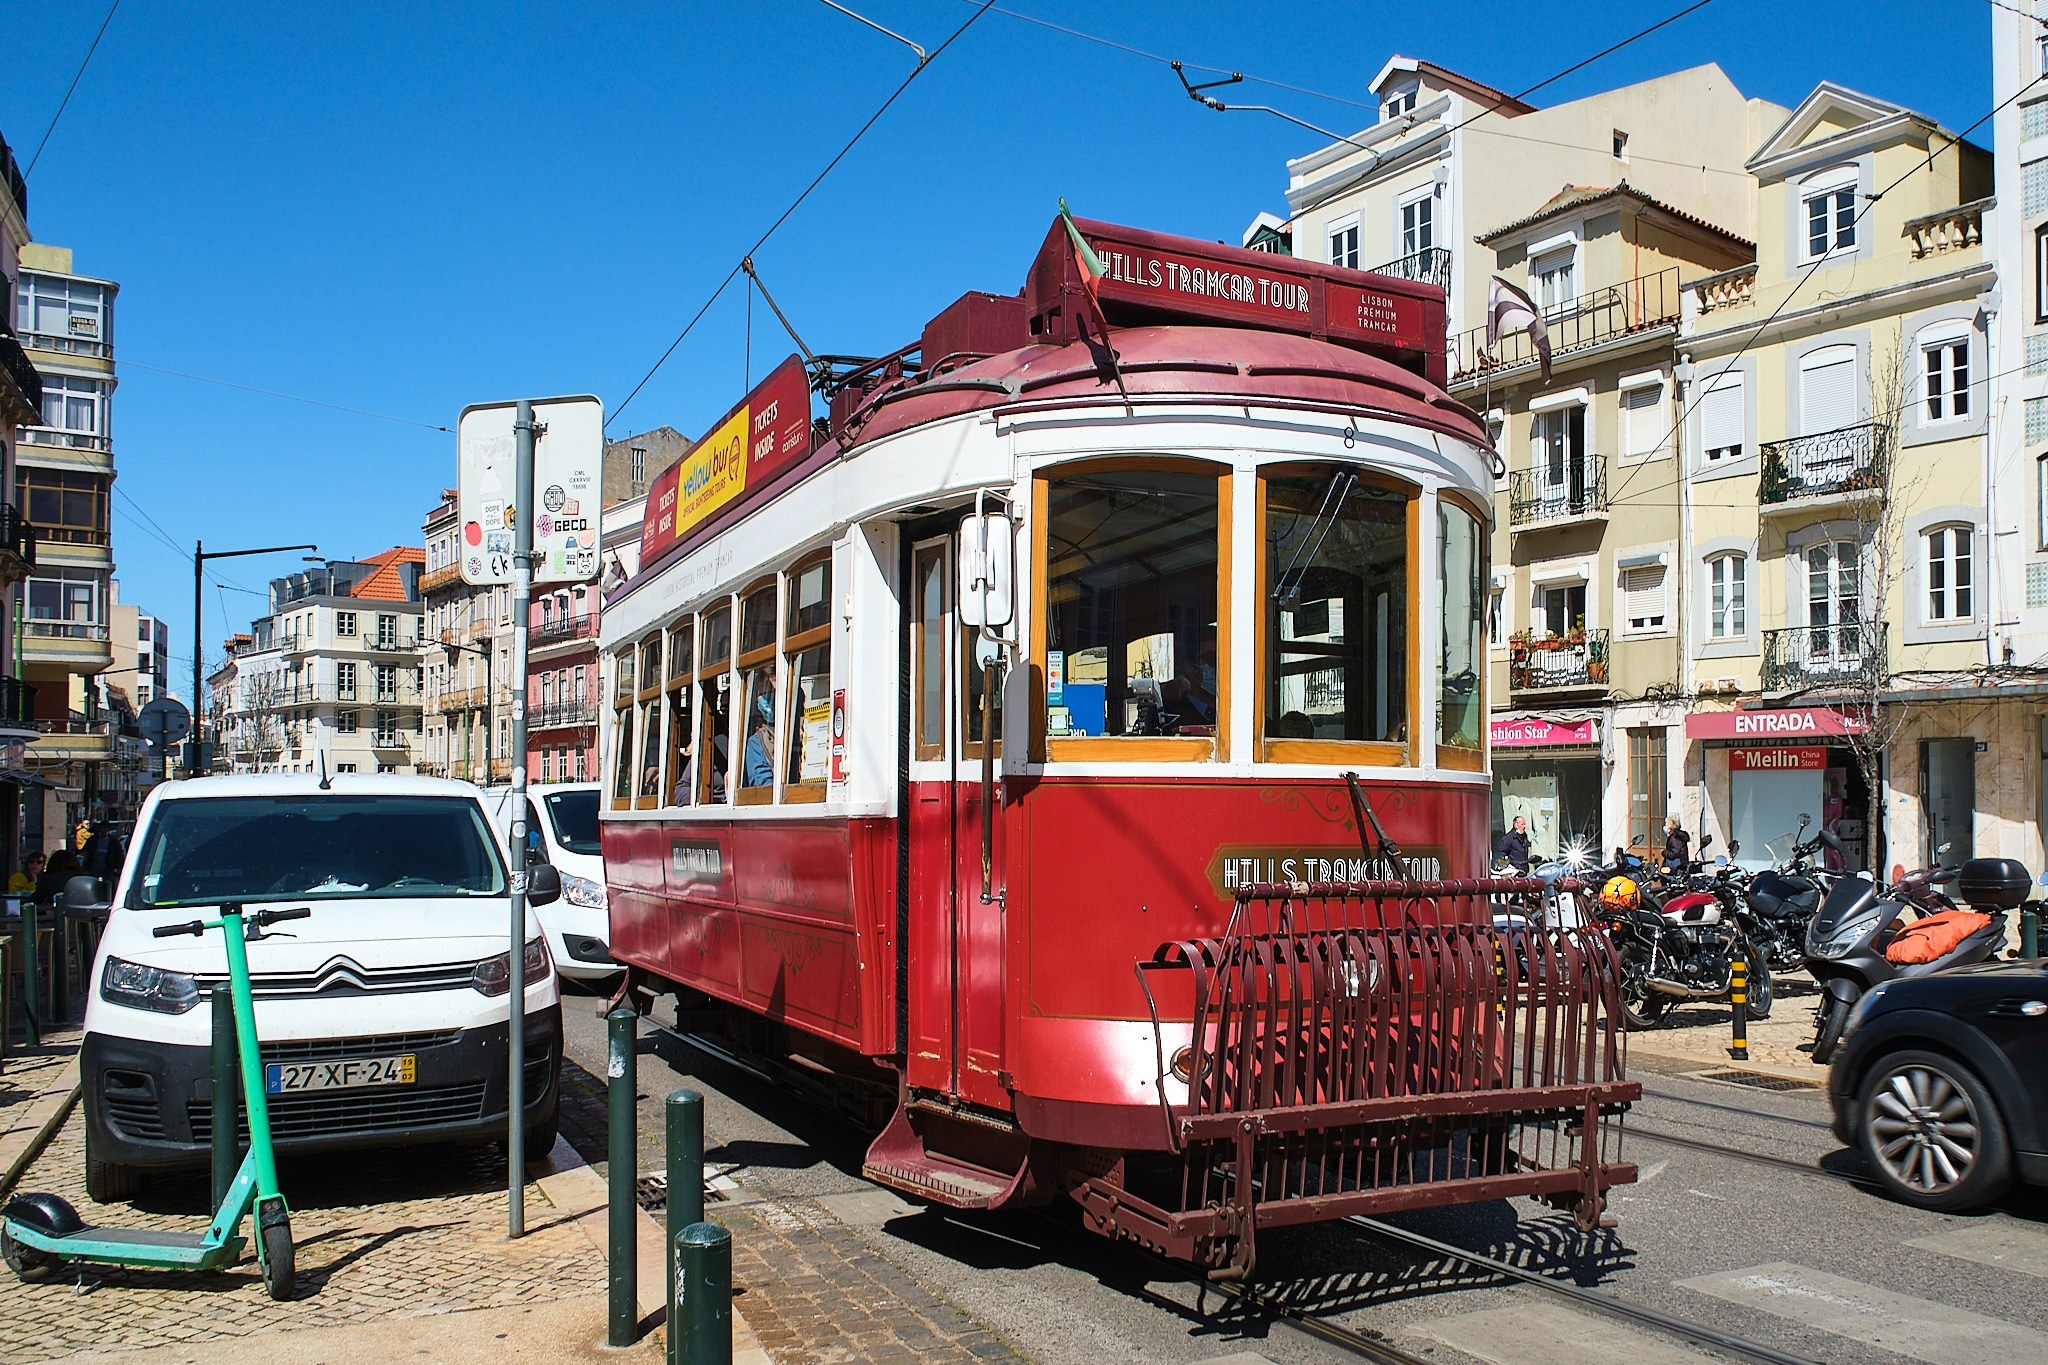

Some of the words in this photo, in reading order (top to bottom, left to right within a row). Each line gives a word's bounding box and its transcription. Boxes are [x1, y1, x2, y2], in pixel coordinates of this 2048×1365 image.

[1098, 250, 1162, 288] HILLS
[1166, 262, 1255, 304] TRAMCAR
[1257, 278, 1309, 313] TOUR
[1361, 294, 1393, 309] LISBON
[1357, 305, 1397, 321] PREMIUM
[1357, 317, 1397, 333] TRAMCAR
[754, 399, 778, 435] TICKETS
[754, 431, 775, 463] INSIDE
[1343, 426, 1355, 449] 8
[659, 486, 676, 512] TICKETS
[658, 511, 673, 535] INSIDE
[1524, 725, 1549, 739] Star
[1735, 712, 1816, 733] ENTRADA
[1745, 750, 1799, 767] Meilin
[1801, 751, 1820, 759] China
[1801, 759, 1819, 767] Store
[1224, 858, 1298, 889] HILLS
[403, 1058, 413, 1066] 19
